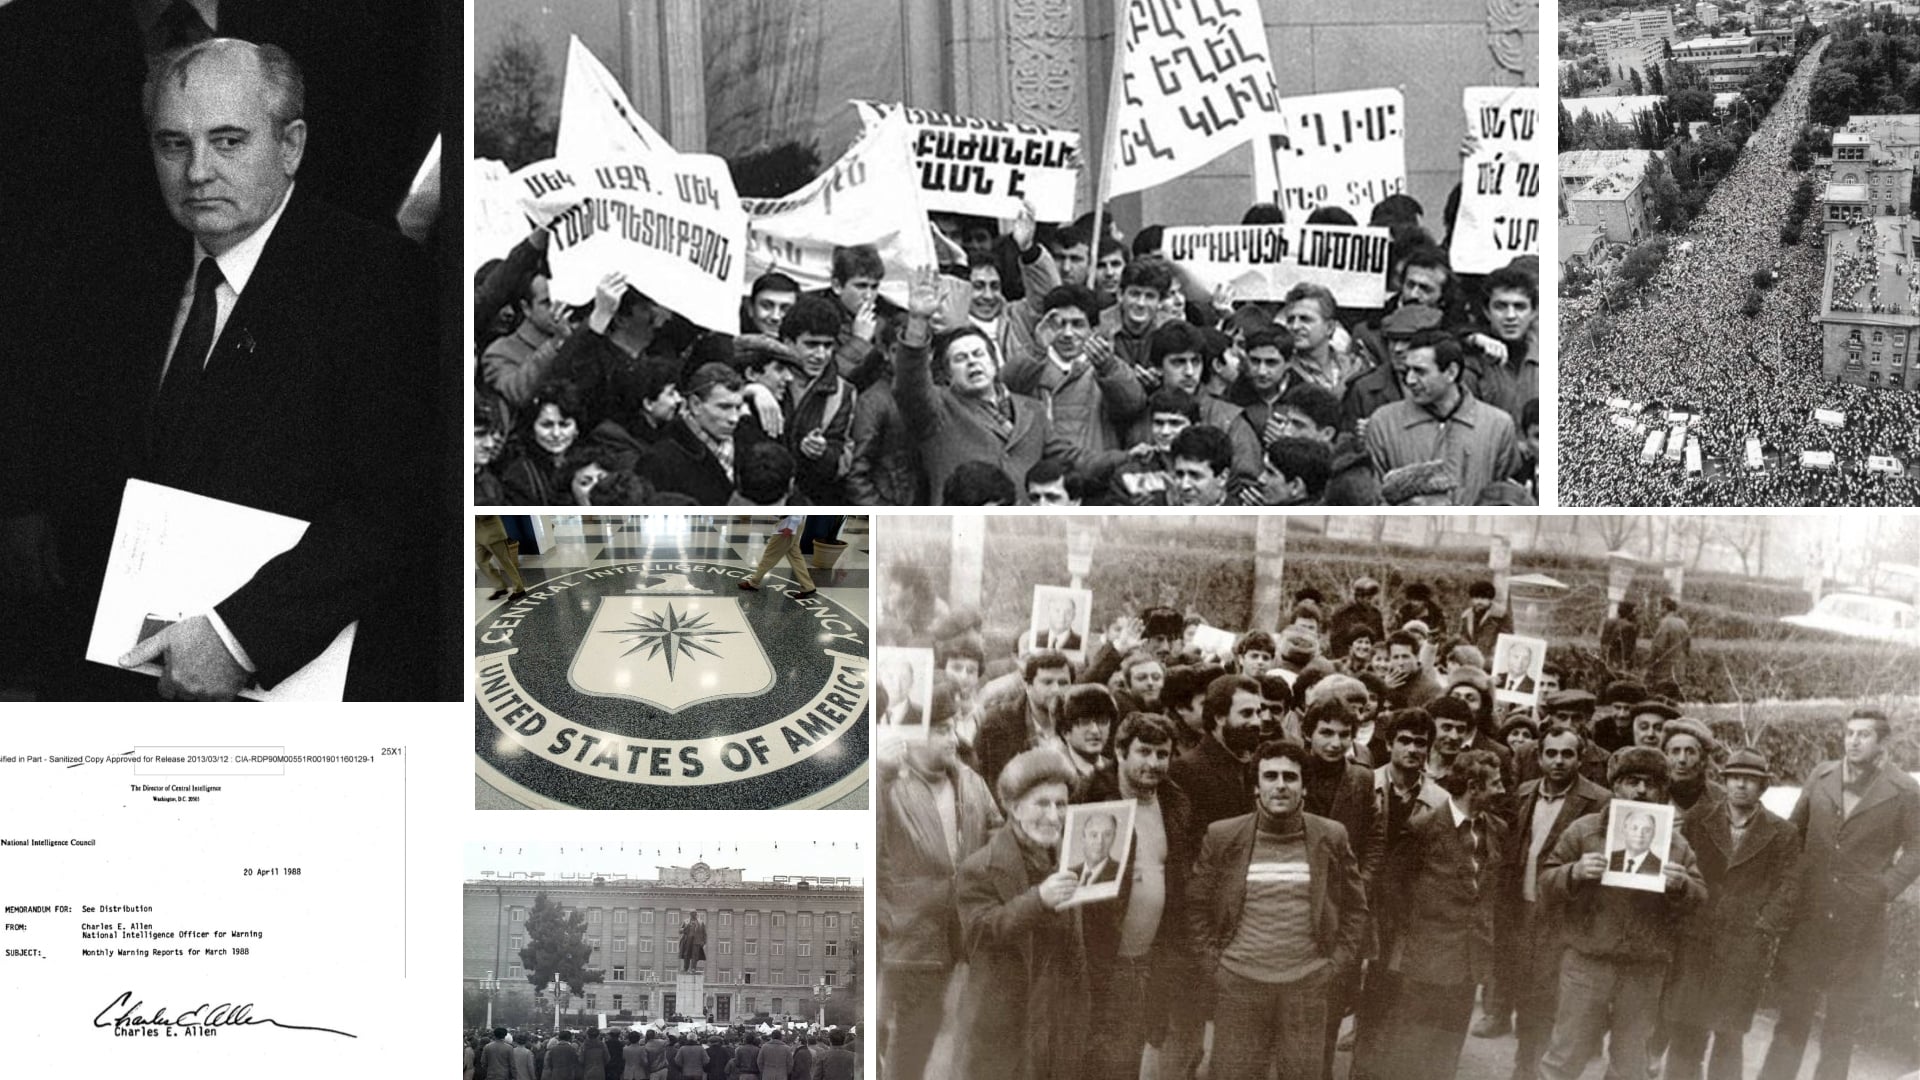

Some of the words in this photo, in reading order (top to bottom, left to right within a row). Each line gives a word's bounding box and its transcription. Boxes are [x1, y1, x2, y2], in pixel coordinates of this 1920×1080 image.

[913, 129, 1077, 168] ԲԱԺԱՆԵԼԻ
[524, 170, 576, 199] ՄԵԿ
[675, 173, 720, 210] ՄԵԿ
[481, 577, 581, 644] CENTRAL
[584, 564, 753, 582] INTELLIGENCE
[766, 583, 864, 645] AGENCY
[480, 662, 548, 737] UNITED
[547, 727, 705, 778] STATES
[721, 735, 770, 772] OF
[780, 664, 867, 755] AMERICA
[381, 747, 402, 756] 25X1
[0, 755, 17, 763] ified
[27, 755, 42, 763] Part
[49, 755, 84, 763] Sanitized
[85, 755, 104, 766] Copy
[106, 755, 141, 766] Approved
[143, 755, 153, 763] for
[155, 755, 186, 763] Release
[187, 755, 229, 763] 2013/03/12
[131, 784, 142, 792] The
[143, 784, 164, 792] Director
[165, 784, 171, 792] of
[171, 784, 190, 792] Central
[192, 784, 221, 794] Intelligence
[1, 839, 30, 847] National
[31, 838, 69, 848] Intelligence
[71, 838, 96, 847] Council
[243, 868, 253, 876] 20
[257, 867, 279, 878] April
[283, 867, 302, 876] 1988
[5, 905, 52, 914] MEMORANDUM
[55, 905, 72, 913] FOR:
[82, 905, 96, 913] See
[100, 905, 153, 913] Distribution
[5, 923, 27, 931] FROM:
[81, 923, 113, 931] Charles
[117, 923, 126, 931] E.
[130, 923, 153, 931] Allen
[82, 931, 118, 939] National
[122, 931, 175, 941] Intelligence
[179, 930, 209, 939] Officer
[213, 930, 227, 938] for
[231, 930, 263, 940] Warning
[82, 948, 114, 958] Monthly
[117, 948, 149, 958] Warning
[152, 948, 184, 958] Reports
[187, 948, 201, 956] for
[204, 948, 227, 956] March
[232, 947, 250, 956] 1988
[114, 1026, 159, 1037] Charles
[165, 1026, 178, 1037] E.
[184, 1026, 218, 1037] Allen
